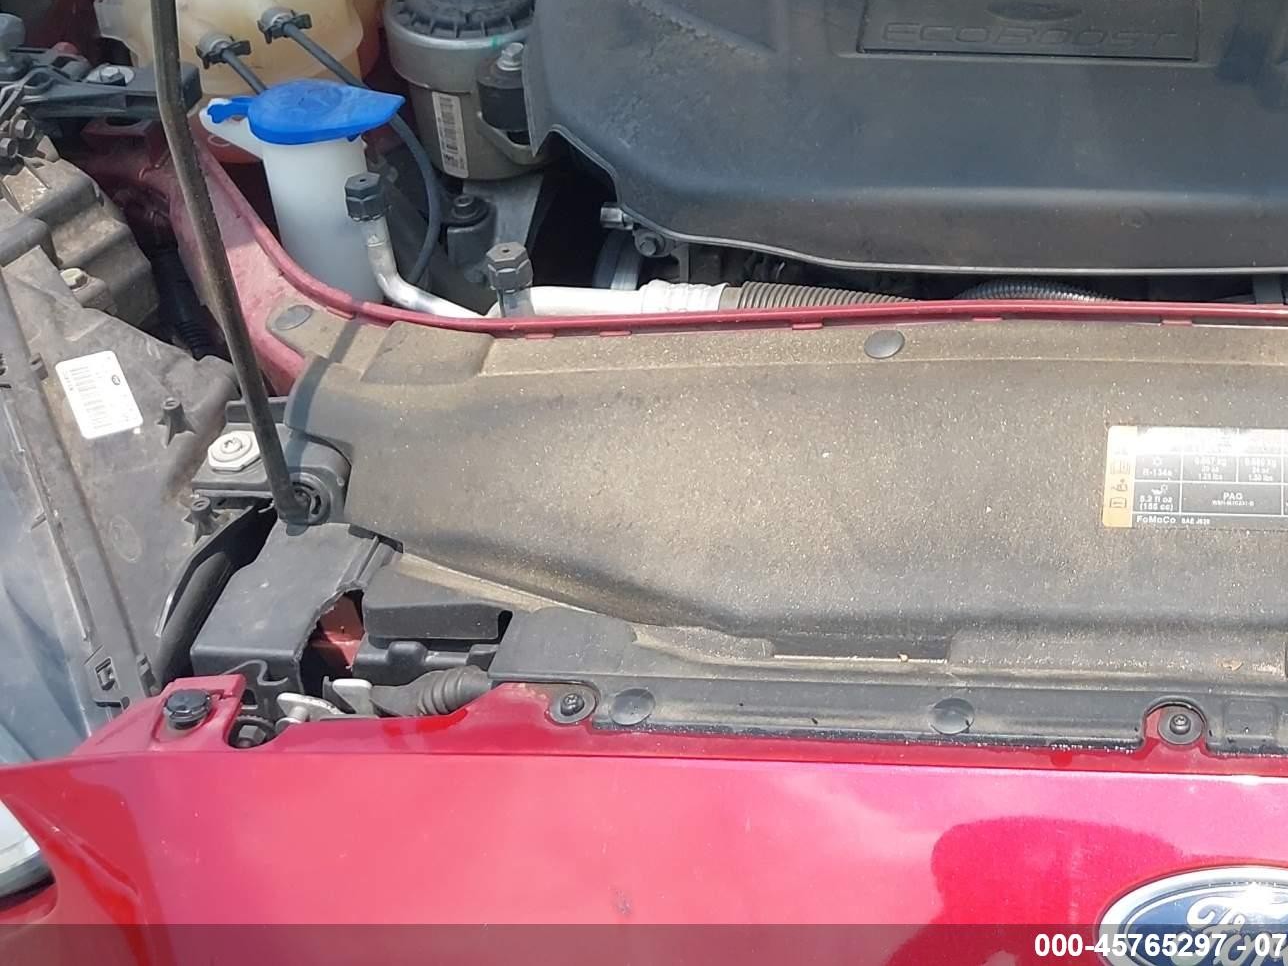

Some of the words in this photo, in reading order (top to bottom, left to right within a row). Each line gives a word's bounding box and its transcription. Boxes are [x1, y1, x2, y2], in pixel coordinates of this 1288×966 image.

[1223, 492, 1243, 500] PAG
[1136, 515, 1177, 524] FoMoCo
[1181, 517, 1195, 525] SAE
